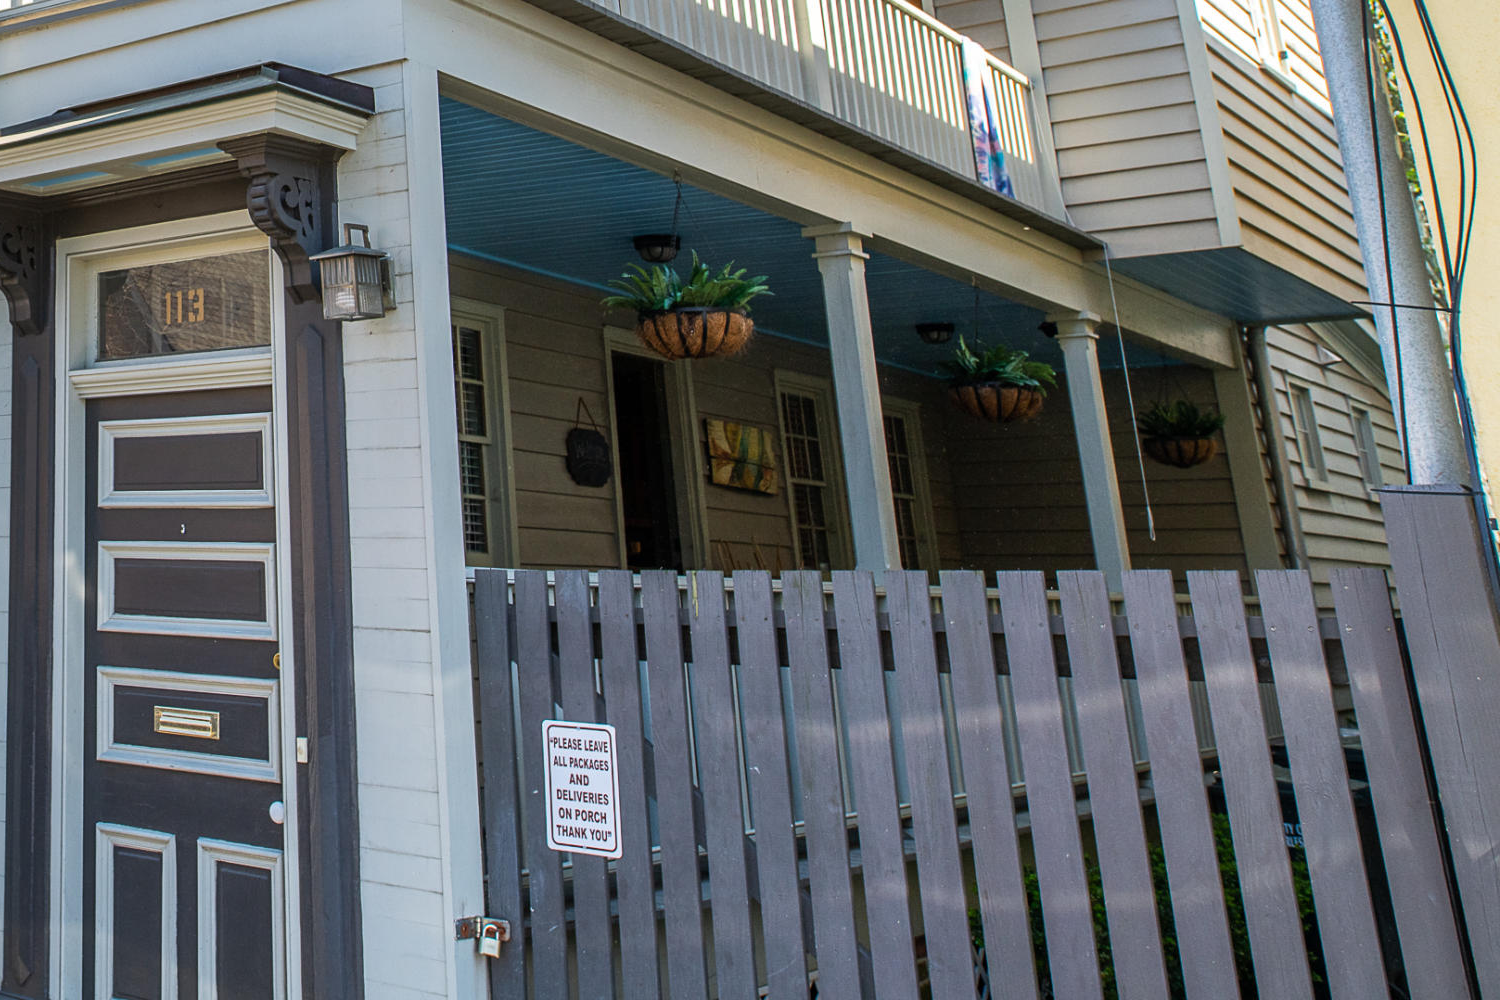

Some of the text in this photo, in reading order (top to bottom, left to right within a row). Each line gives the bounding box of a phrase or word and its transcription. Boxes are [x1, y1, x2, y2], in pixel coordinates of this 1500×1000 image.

[165, 288, 205, 325] 113
[584, 739, 608, 753] LEAVE
[553, 755, 609, 772] ALL PACKAGES
[569, 773, 590, 786] AND
[556, 788, 609, 806] DELIVERIES
[558, 807, 607, 825] ON PORCH
[556, 824, 588, 840] THANK
